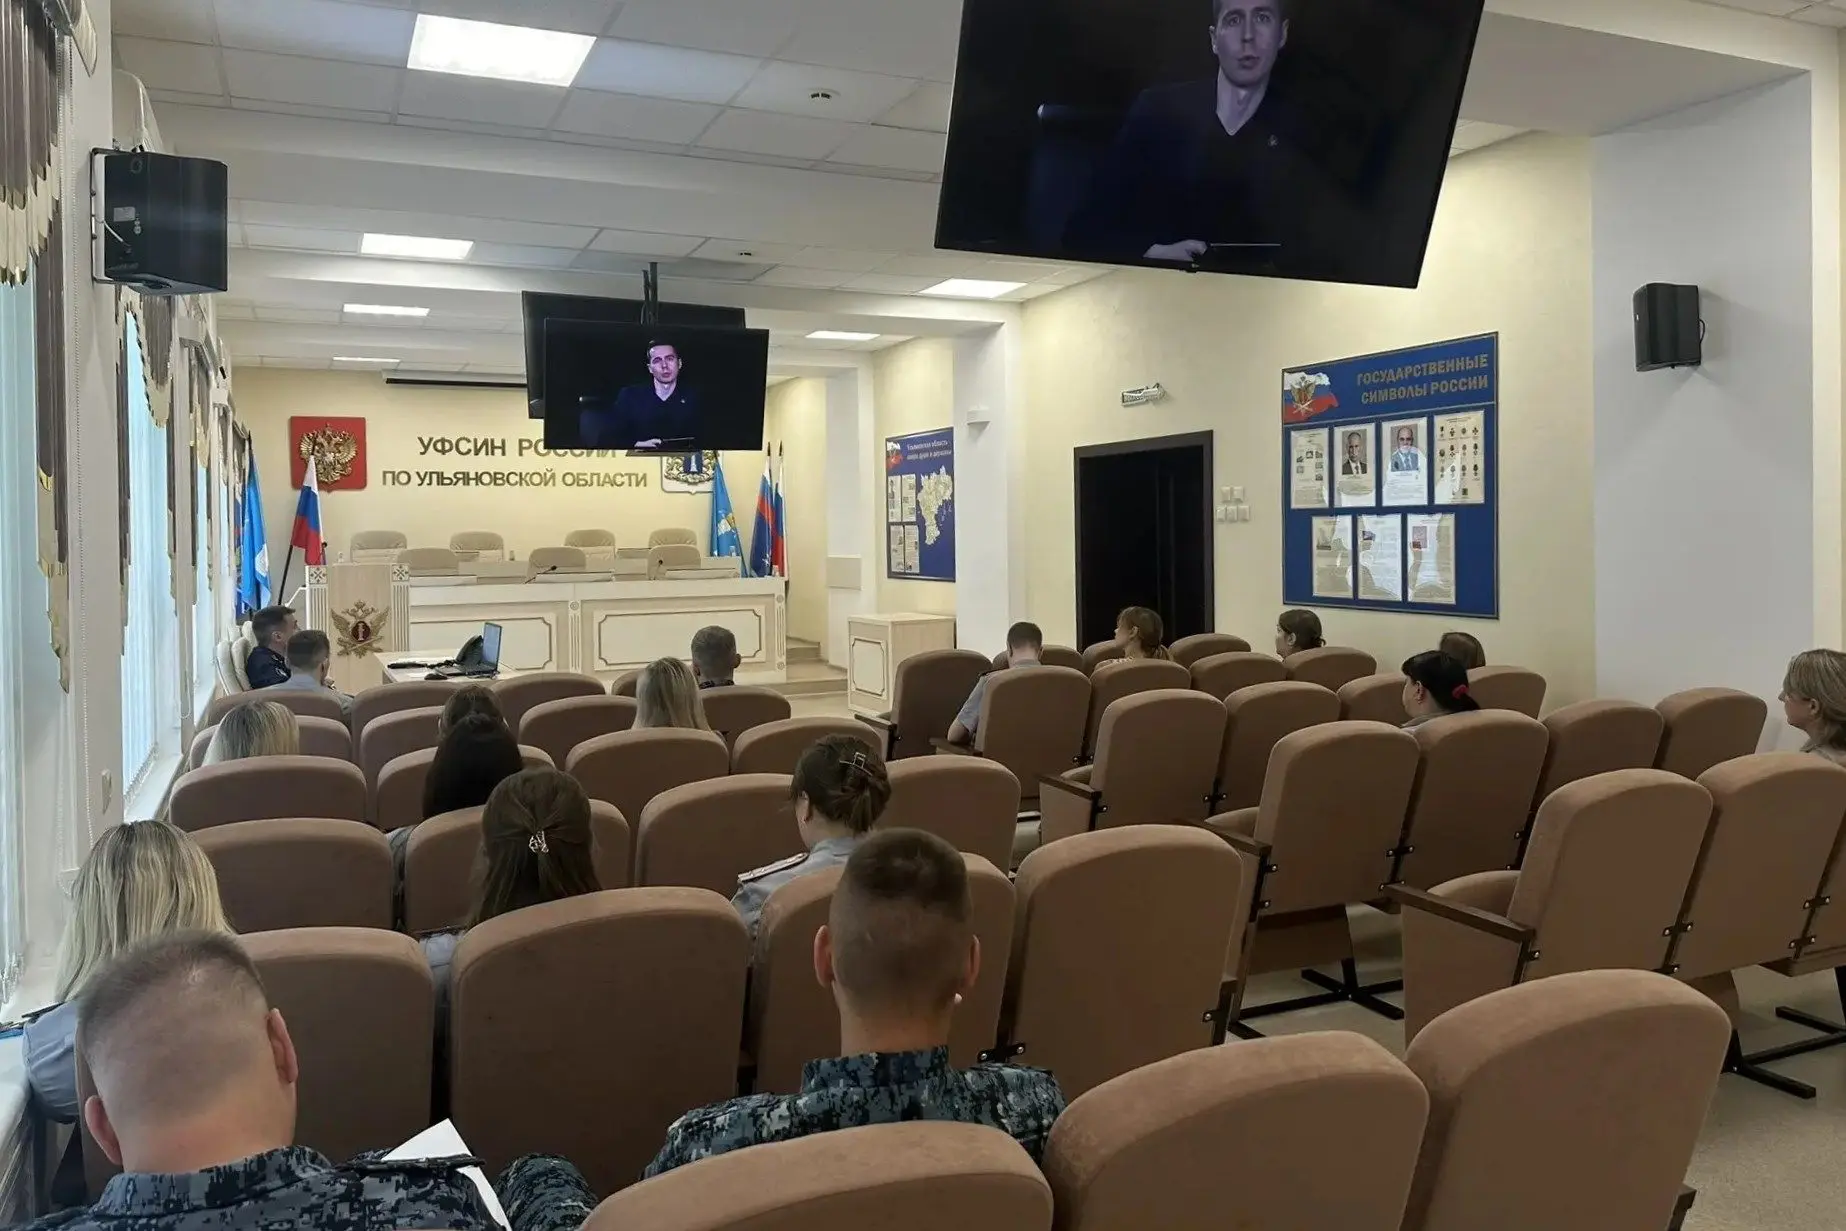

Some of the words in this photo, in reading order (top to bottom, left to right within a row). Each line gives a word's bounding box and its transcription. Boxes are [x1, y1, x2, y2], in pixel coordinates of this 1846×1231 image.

[1357, 353, 1489, 386] ГОСУДАРСТВЕННЫЕ
[1361, 384, 1428, 405] СИМВОЛЫ
[1430, 374, 1489, 396] РОССИИ
[417, 436, 506, 456] УФСИН
[382, 470, 412, 486] ПО
[415, 468, 556, 487] УЛЬЯНОВСКОЙ
[561, 472, 648, 488] ОБЛАСТИ
